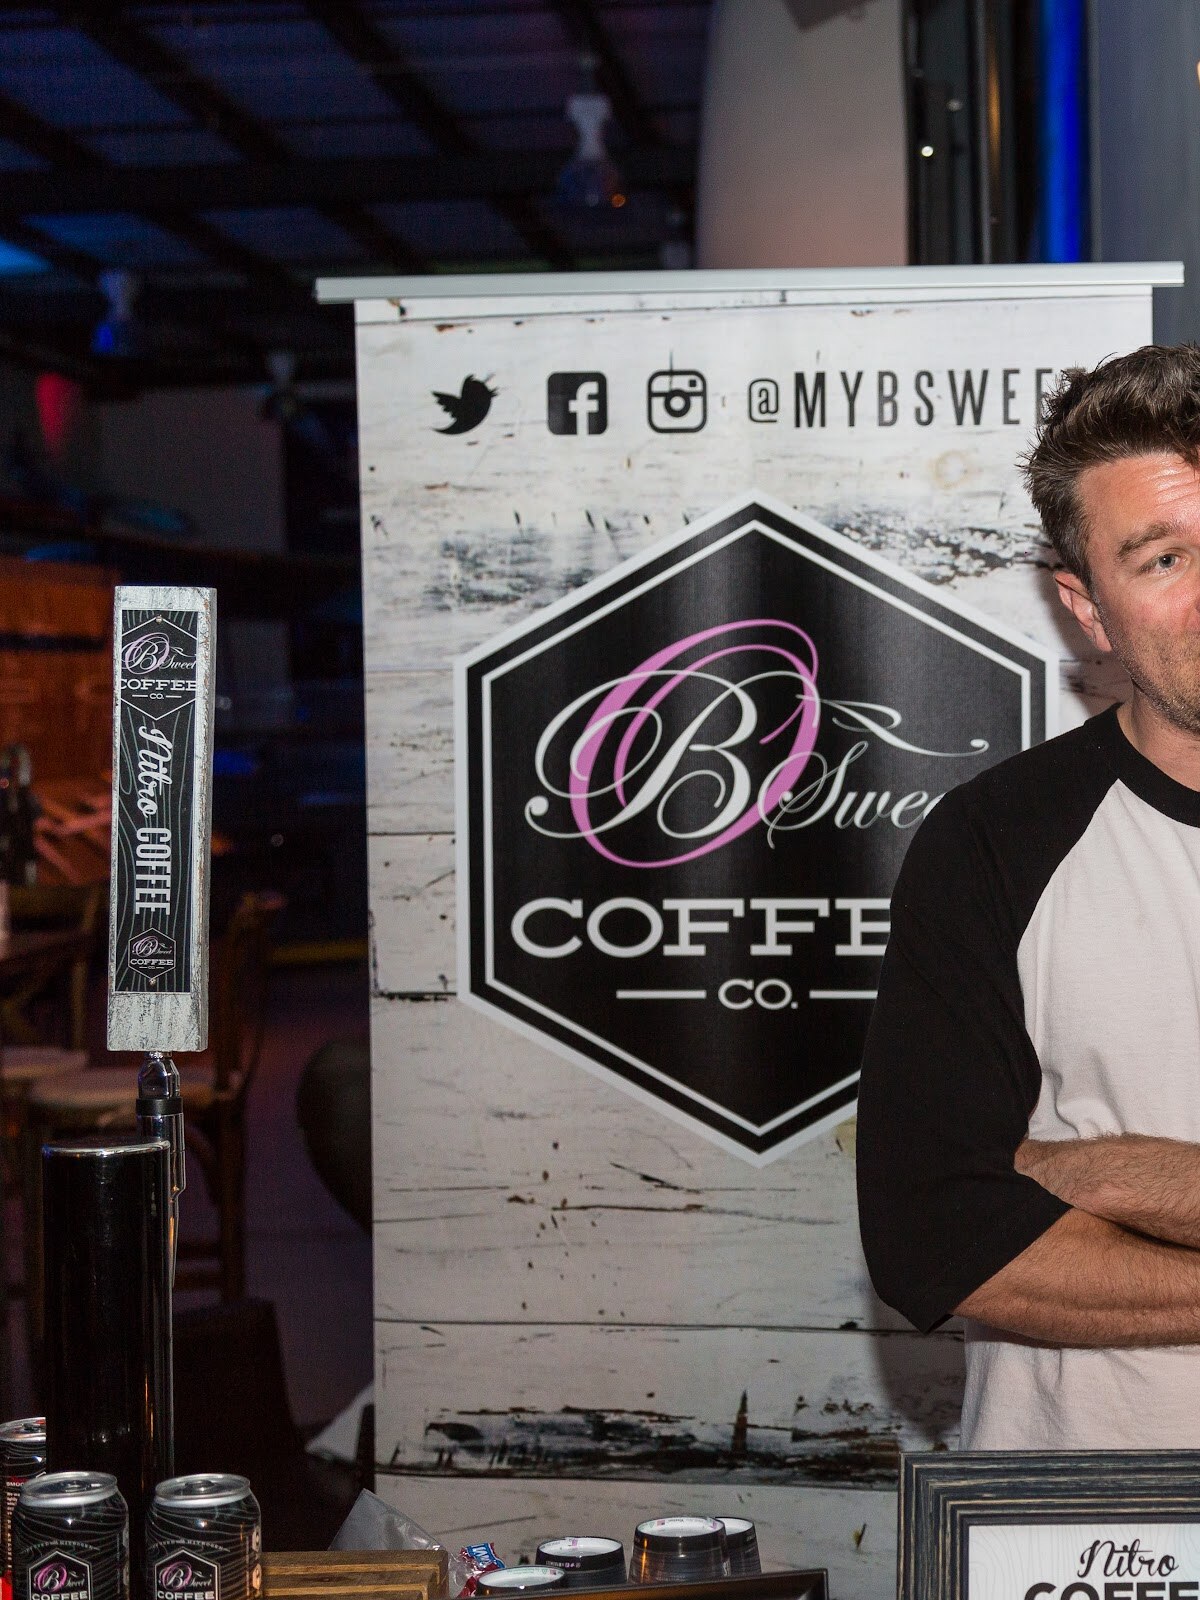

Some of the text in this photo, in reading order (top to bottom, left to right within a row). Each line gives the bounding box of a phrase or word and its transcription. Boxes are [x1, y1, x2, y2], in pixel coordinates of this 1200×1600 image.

[748, 367, 1086, 428] @MYBSWEE
[757, 741, 947, 850] Swe
[135, 726, 173, 916] Nitro COFFEE
[130, 958, 174, 966] COFFEE
[718, 978, 798, 1010] CO.
[1077, 1538, 1179, 1578] Nitro
[32, 1590, 88, 1600] COFFEE
[157, 1590, 215, 1600] COFFEE
